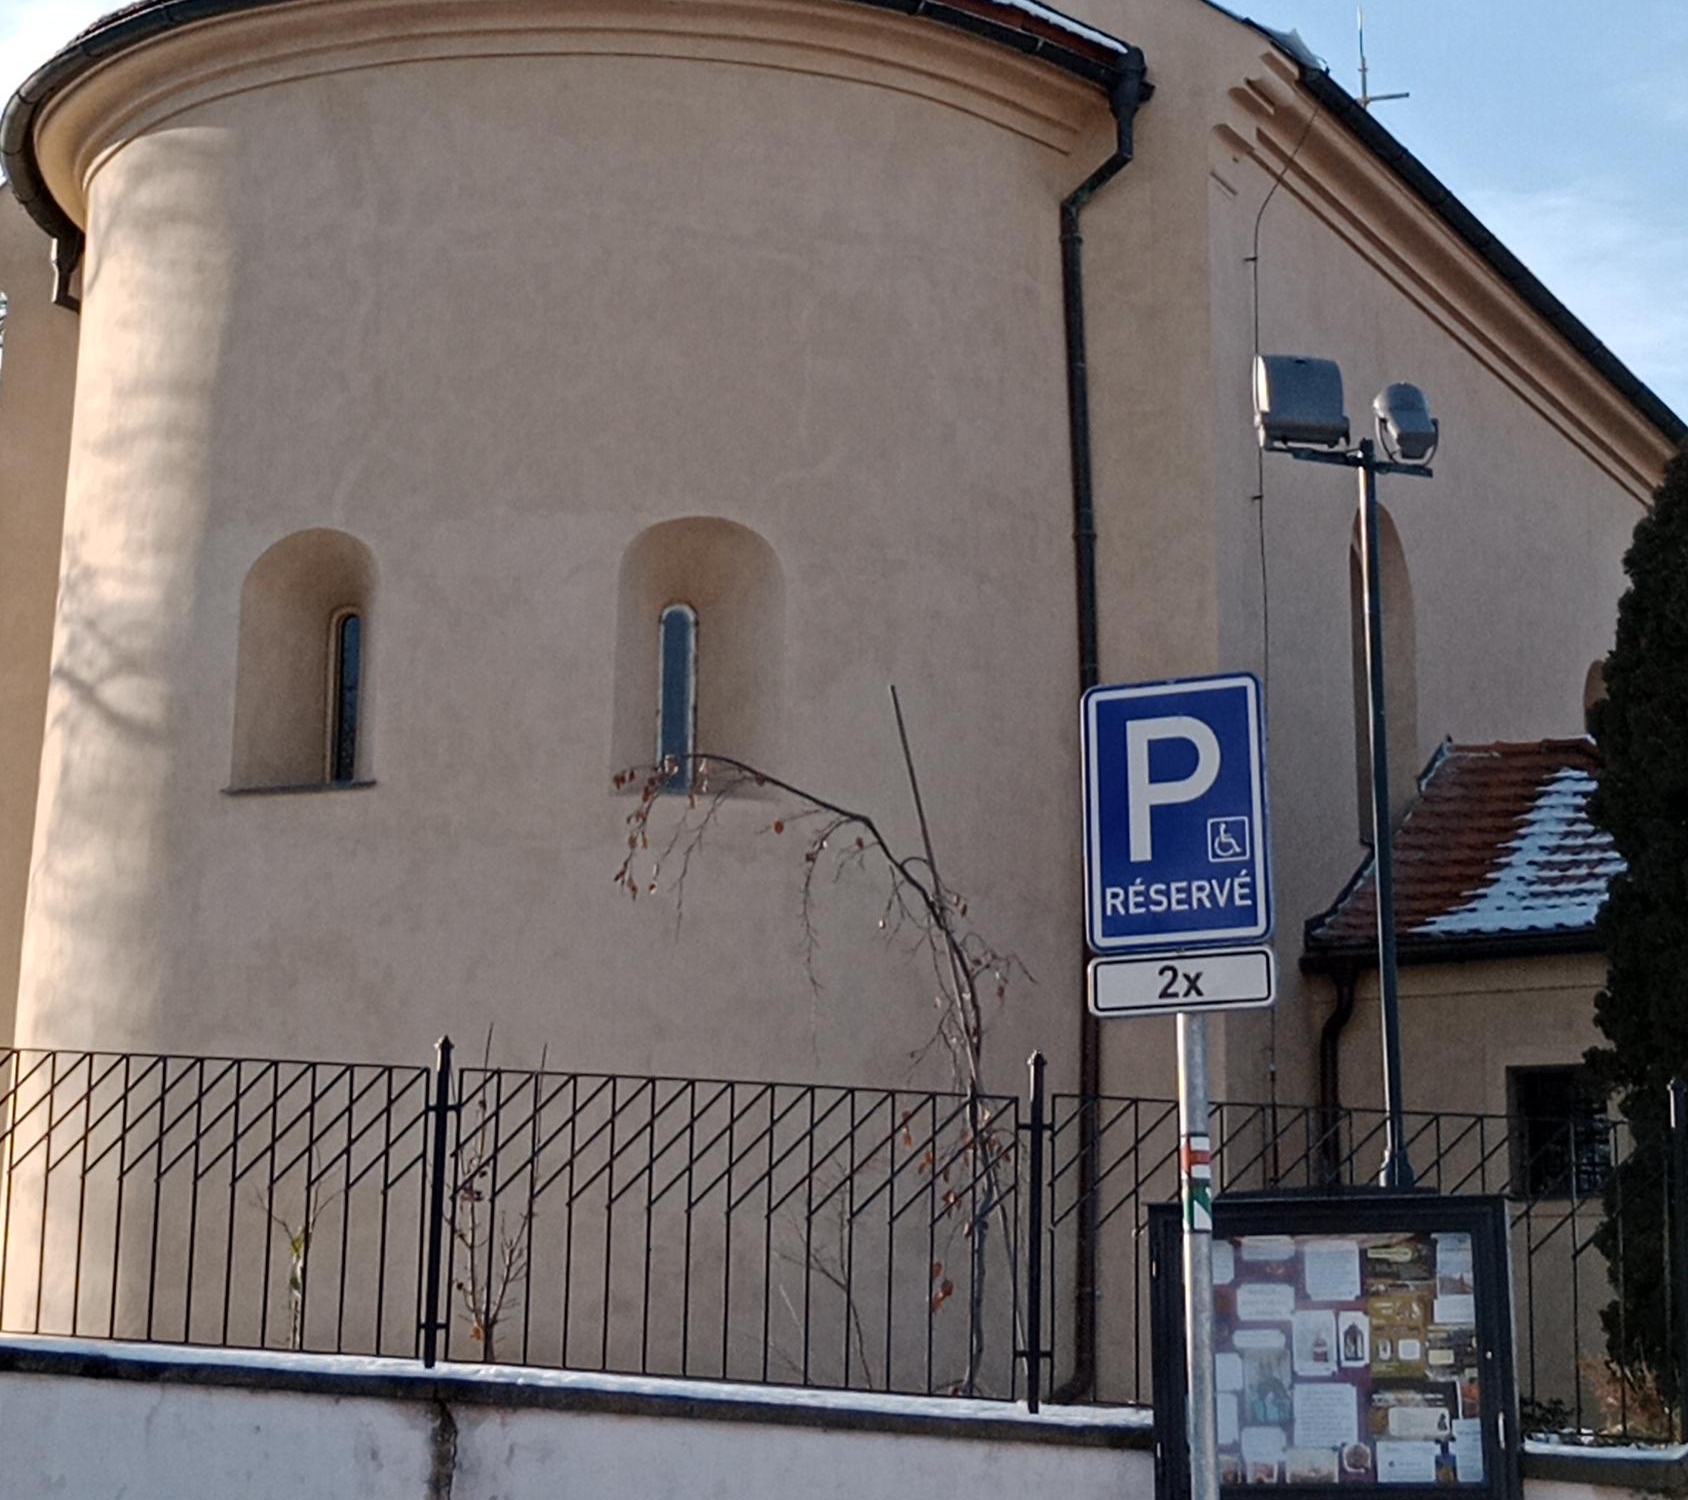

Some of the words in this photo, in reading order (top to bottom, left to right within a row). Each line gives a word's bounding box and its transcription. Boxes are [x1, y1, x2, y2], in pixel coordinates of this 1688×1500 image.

[1126, 715, 1220, 862] P
[1105, 870, 1252, 916] RÉSERVÉ
[1157, 965, 1204, 999] 2x
